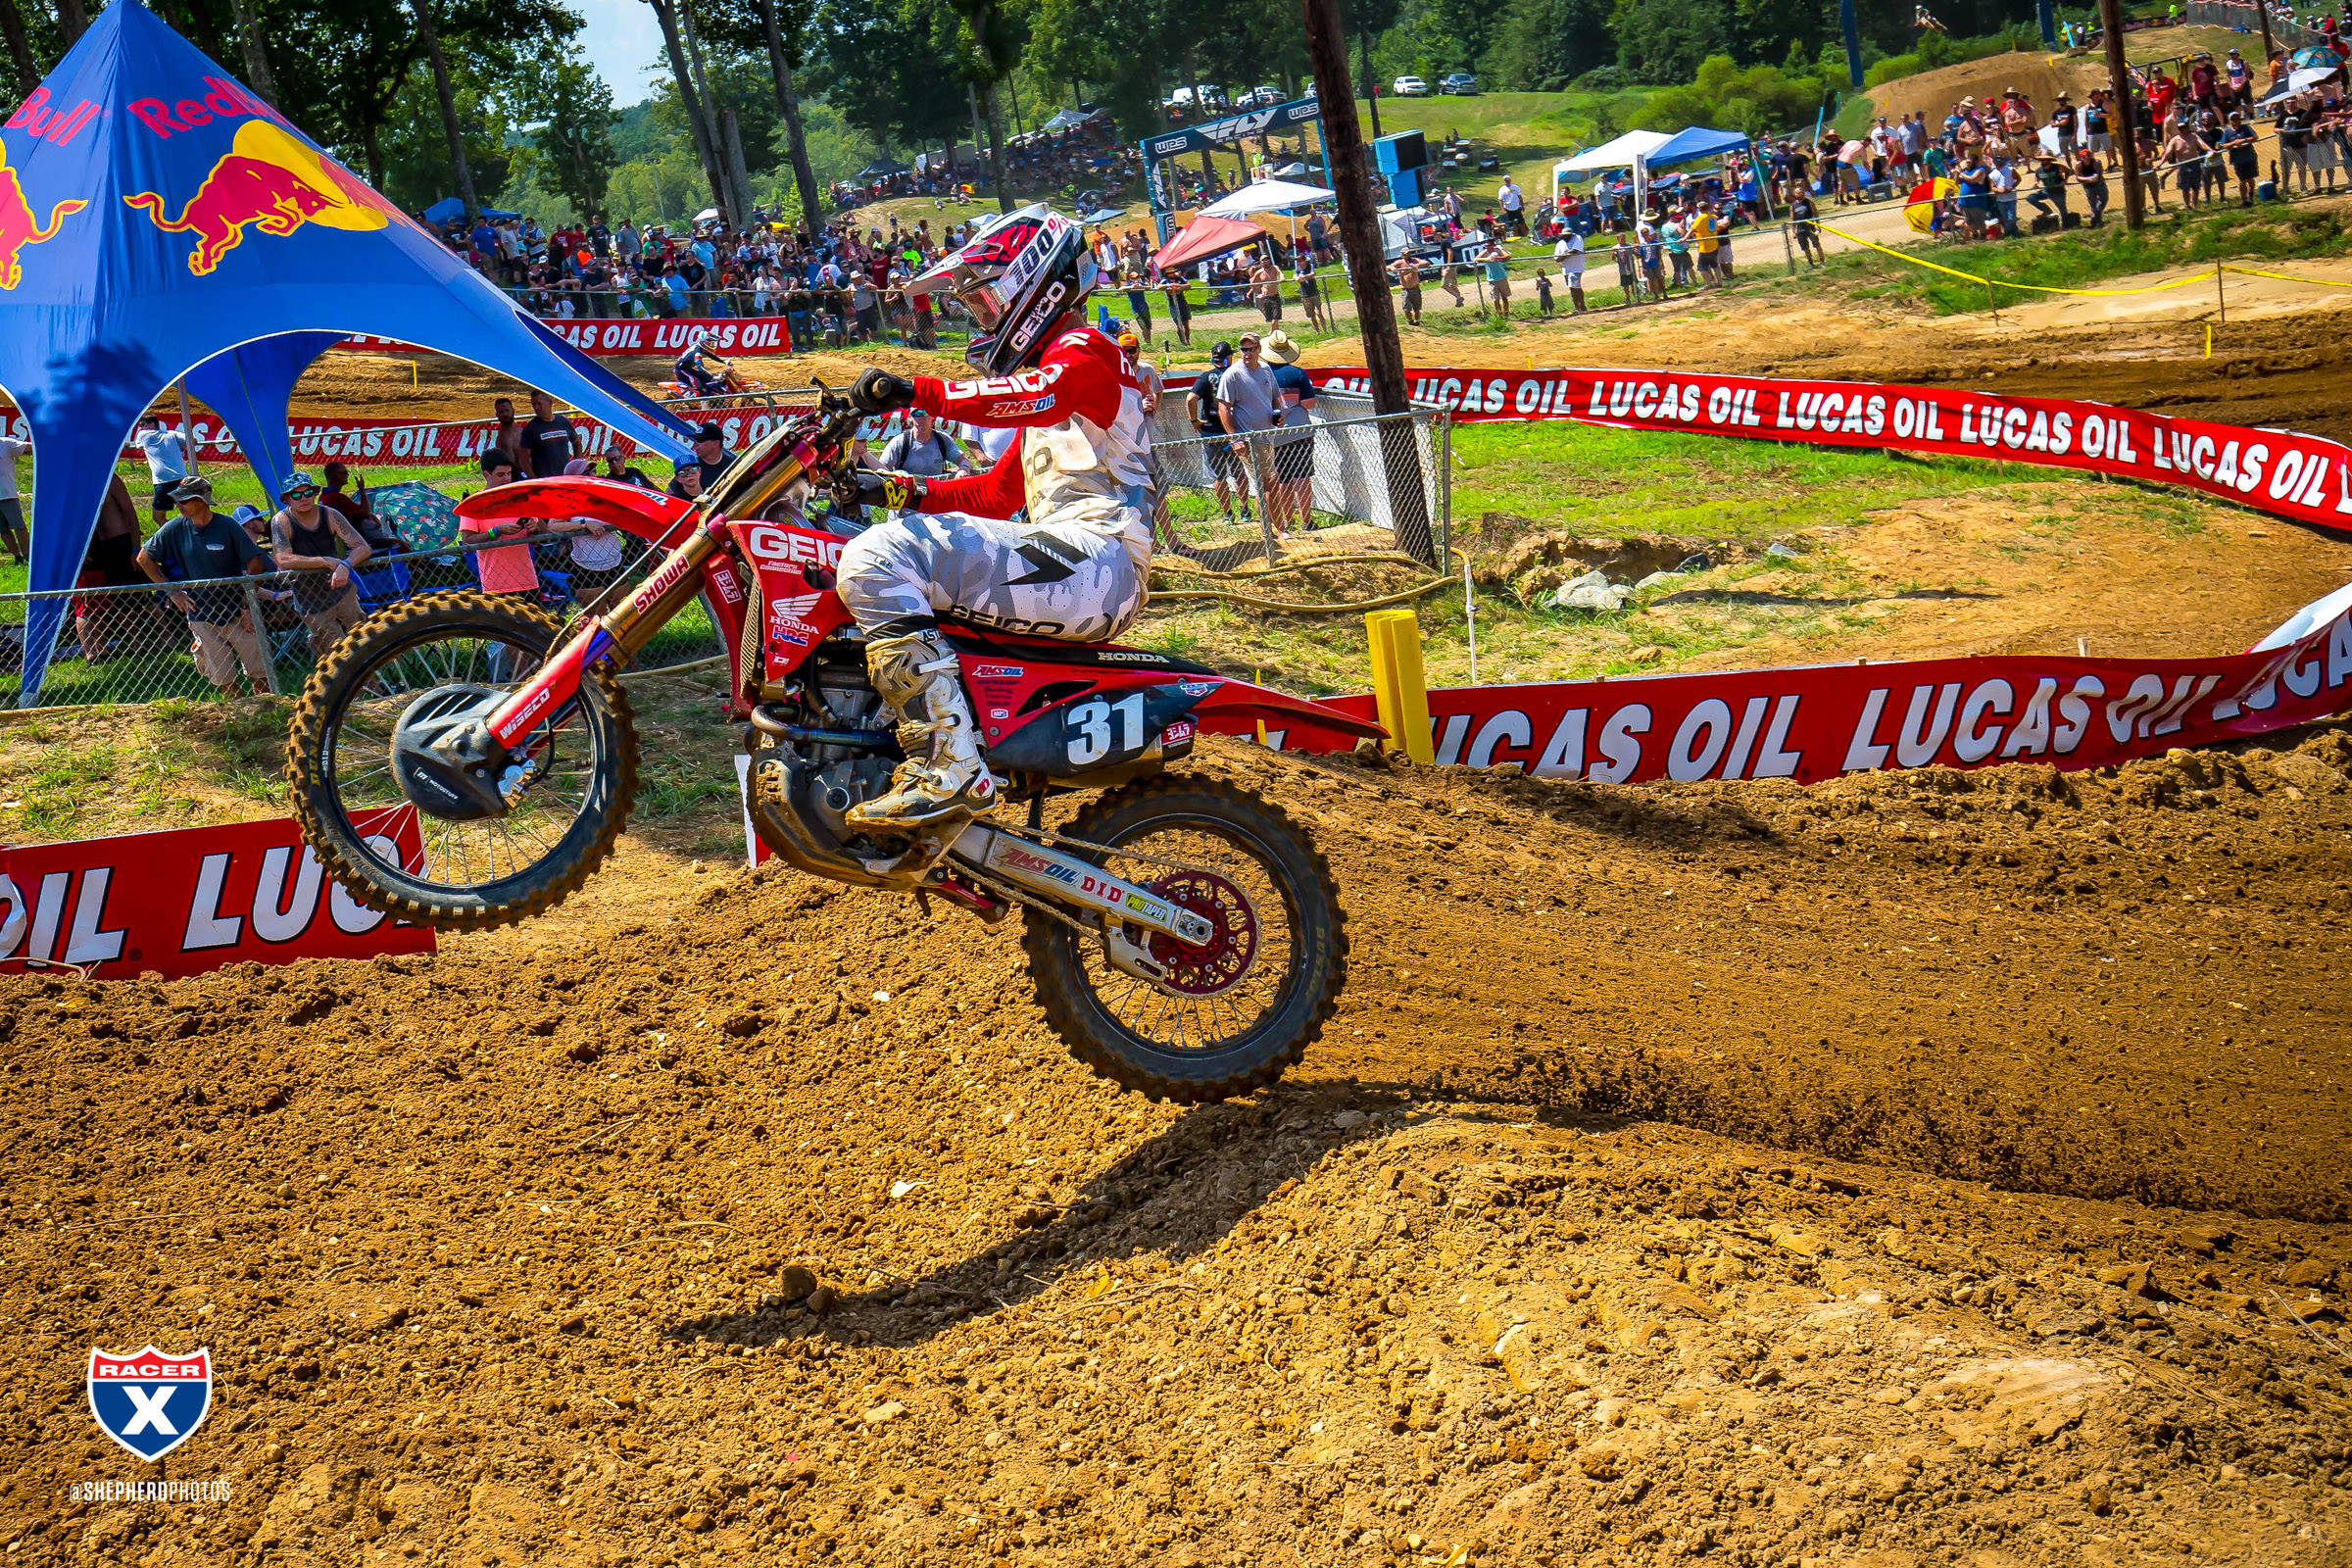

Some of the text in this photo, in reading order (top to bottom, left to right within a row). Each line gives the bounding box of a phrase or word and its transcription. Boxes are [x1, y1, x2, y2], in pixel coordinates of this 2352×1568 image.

[4, 87, 101, 146] Bull
[127, 75, 248, 138] Red
[1196, 109, 1277, 140] FLY
[1289, 103, 1319, 120] WPS
[1155, 137, 1187, 153] WPS
[1010, 281, 1066, 351] GEICO
[603, 325, 642, 349] OIL
[741, 323, 781, 348] OIL
[944, 364, 1062, 400] GEICO
[986, 393, 1055, 417] AMSOIL
[391, 427, 441, 457] OIL
[1413, 378, 1507, 414] UCAS
[1515, 379, 1571, 415] OIL
[1588, 380, 1701, 422] LUCAS
[1708, 386, 1761, 426] OIL
[1777, 391, 1885, 436] LUCAS
[1892, 397, 1944, 441] OIL
[1960, 404, 2073, 455] LUCAS
[2082, 415, 2137, 464] OIL
[2153, 426, 2269, 493] LUCAS
[2269, 449, 2329, 507] OIL
[750, 526, 845, 569] GEIC
[633, 555, 690, 614] SHOWA
[769, 615, 819, 634] HONDA
[772, 625, 808, 646] HRC
[950, 604, 1065, 635] GEICO
[1098, 652, 1170, 663] HONDA
[499, 688, 551, 740] WISECO
[1068, 693, 1145, 764] 31
[1667, 696, 1802, 781] OIL
[1841, 676, 2105, 771] LUCAS
[2106, 674, 2222, 742] OIL
[1000, 848, 1081, 888] AMSOIL
